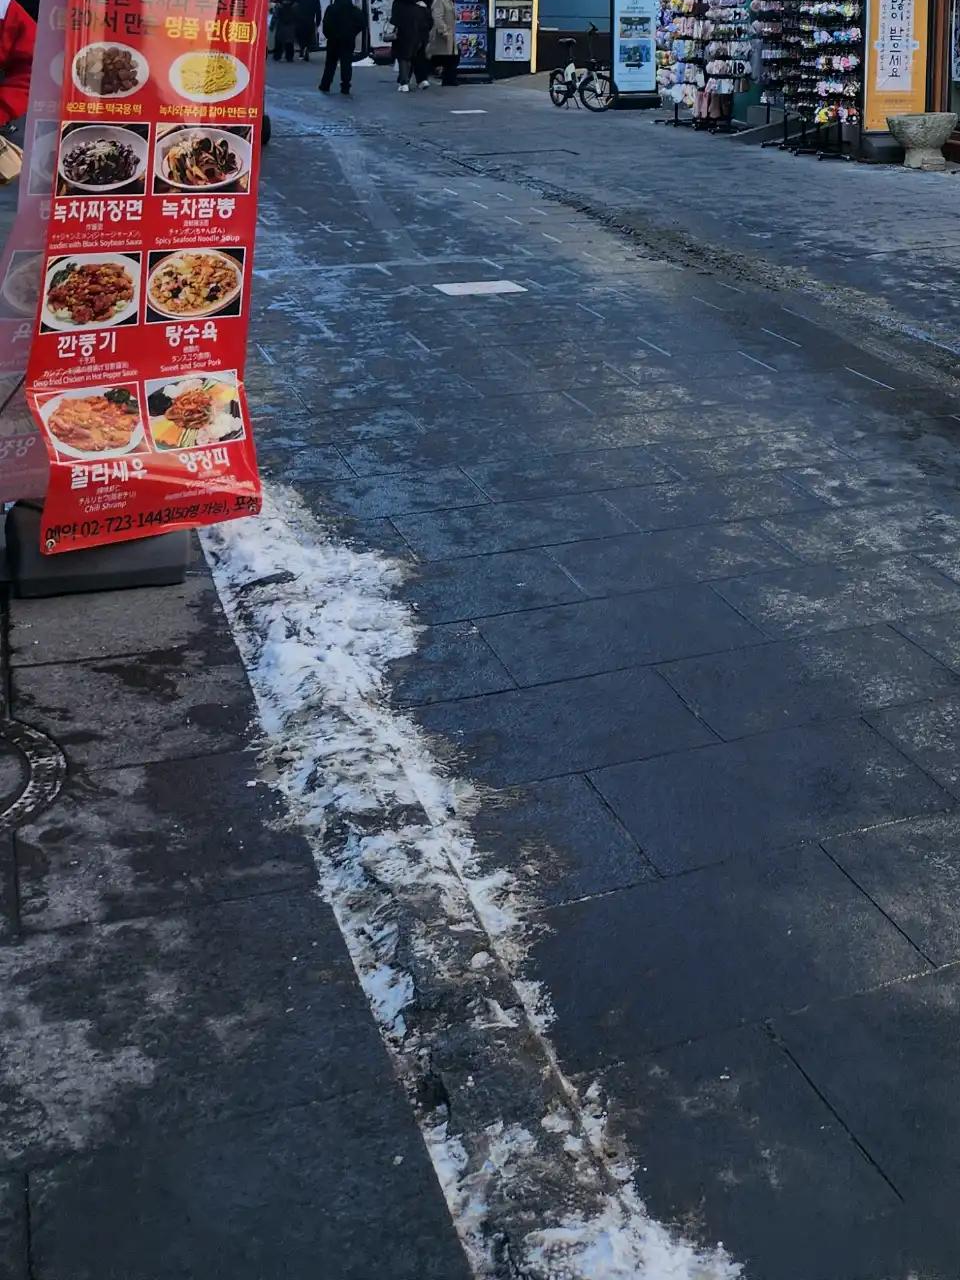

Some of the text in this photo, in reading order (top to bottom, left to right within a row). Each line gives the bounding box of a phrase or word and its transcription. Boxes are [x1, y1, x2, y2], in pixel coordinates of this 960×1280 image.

[165, 16, 199, 39] 명품
[54, 199, 143, 223] 녹차짜장면
[162, 198, 235, 220] 녹차짬뽕
[155, 234, 240, 245] Spicy Seafood Noodle Soup
[57, 332, 116, 358] 깐풍기
[165, 321, 218, 348] 탕수육
[160, 363, 179, 372] Sweet
[193, 361, 206, 369] Sour
[208, 360, 221, 368] Pork
[63, 375, 85, 384] Chicken
[92, 372, 102, 381] Hot
[179, 447, 230, 472] 양장피
[71, 458, 147, 490] 칠리새우
[85, 501, 126, 513] Chili Shrimp
